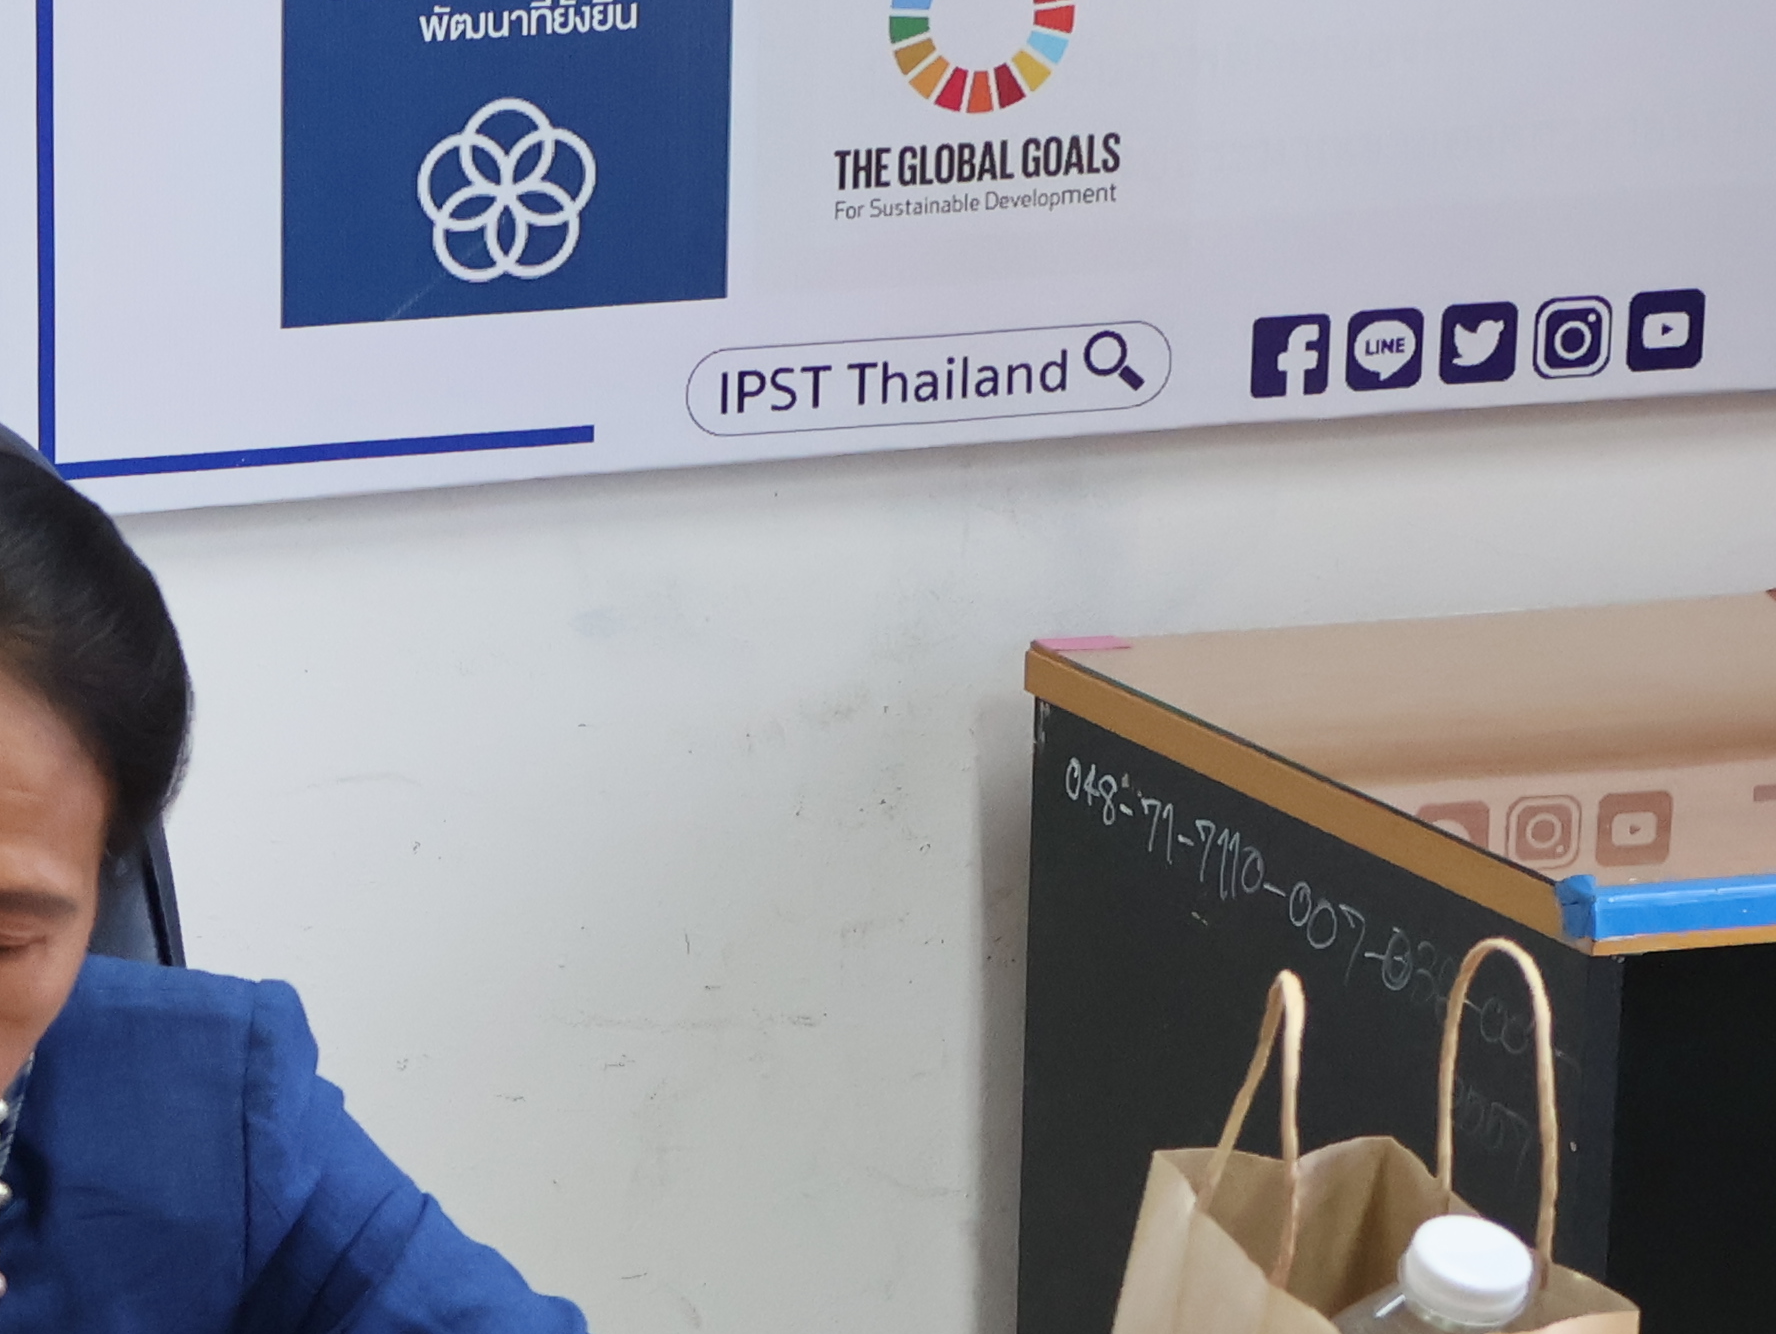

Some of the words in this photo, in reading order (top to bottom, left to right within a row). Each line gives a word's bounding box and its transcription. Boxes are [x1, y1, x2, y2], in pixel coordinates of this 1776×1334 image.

[834, 147, 891, 190] THE
[898, 140, 1014, 187] GLOBAL
[1021, 132, 1121, 178] GOALS
[834, 200, 865, 220] For
[869, 192, 979, 218] Sustainable
[985, 183, 1117, 211] Development
[1365, 337, 1405, 356] LINE
[718, 364, 832, 416] IPST
[848, 349, 1068, 407] Thailand
